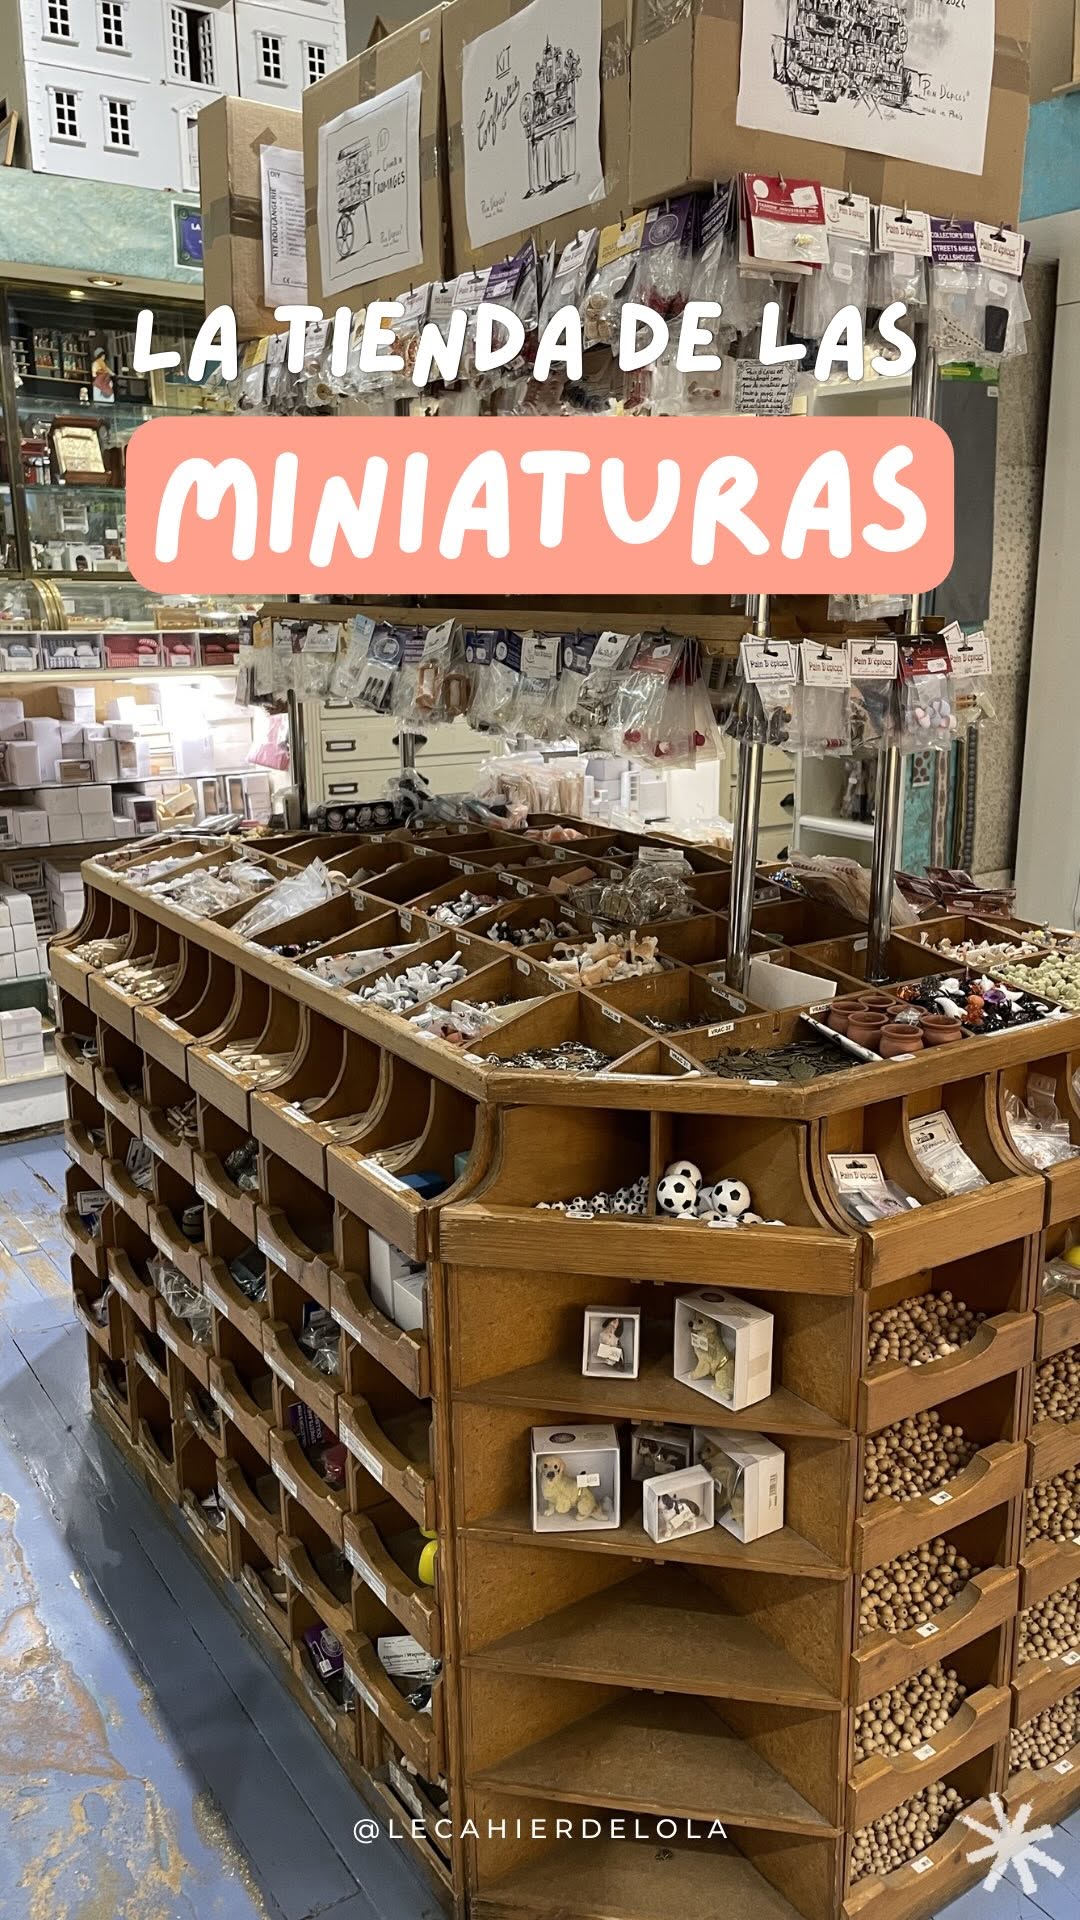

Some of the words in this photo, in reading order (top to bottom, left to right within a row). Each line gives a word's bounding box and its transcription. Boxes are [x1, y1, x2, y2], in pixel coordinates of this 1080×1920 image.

[496, 45, 512, 73] KIT
[270, 189, 279, 242] BOULANGERIE
[885, 223, 899, 234] Pain
[932, 244, 958, 252] STREETS
[980, 238, 992, 250] Pain
[937, 253, 975, 262] DOLLSHOUSE
[751, 660, 763, 668] Pain
[711, 1027, 725, 1035] VRAC
[672, 1051, 683, 1064] VRAC
